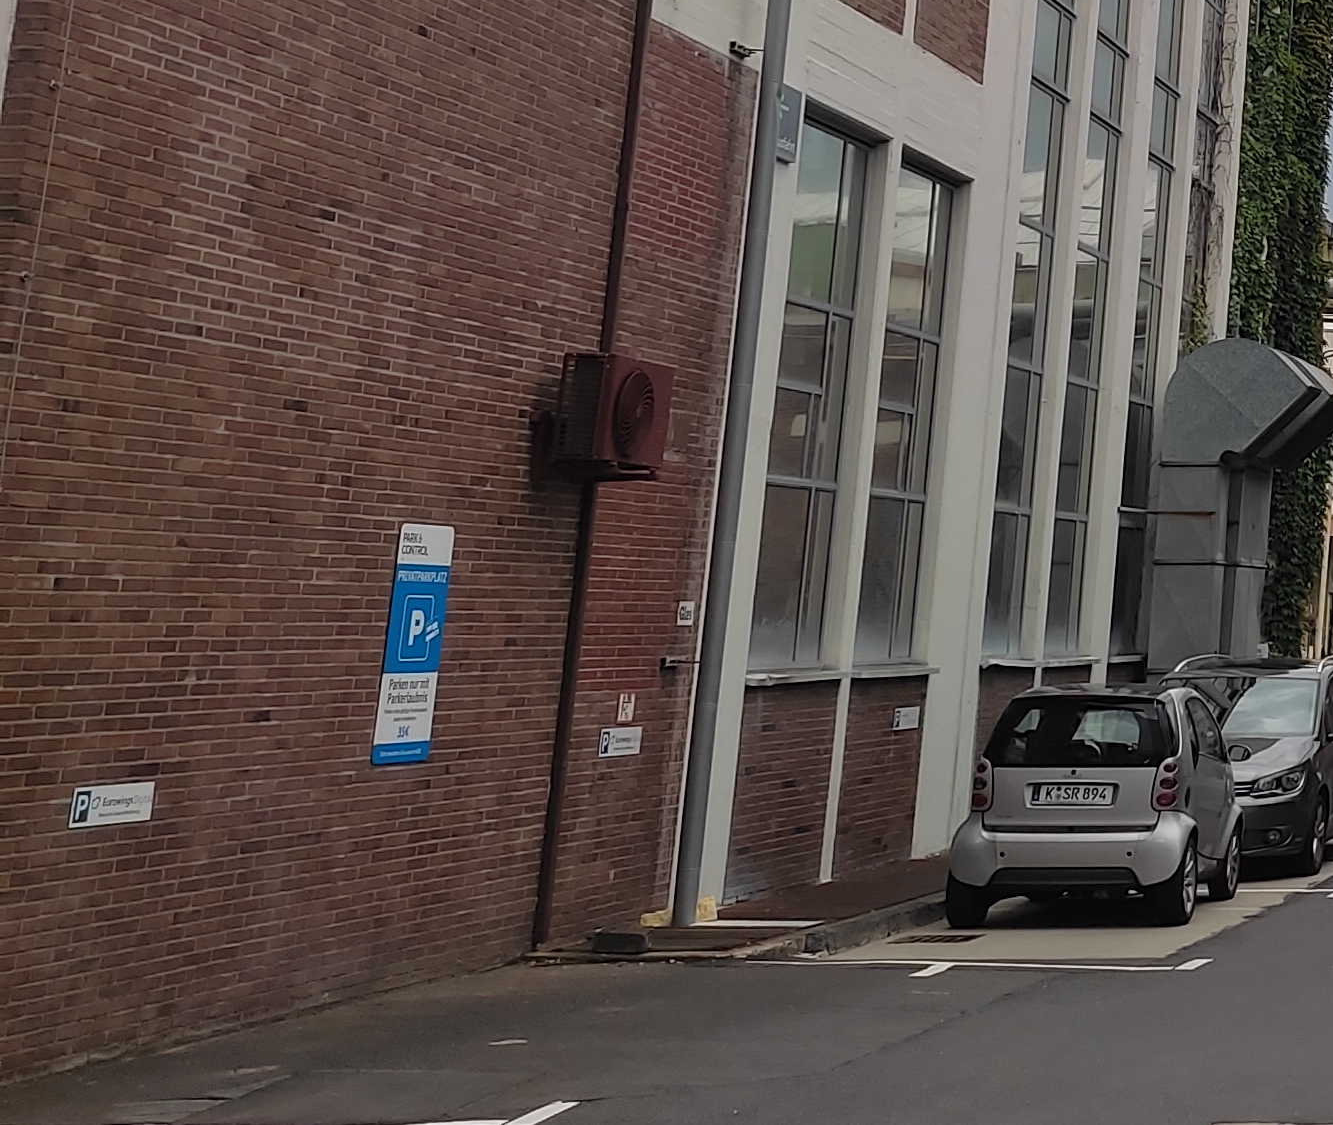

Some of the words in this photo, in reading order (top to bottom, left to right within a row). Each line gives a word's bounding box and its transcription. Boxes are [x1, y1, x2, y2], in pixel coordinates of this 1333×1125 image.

[402, 545, 428, 556] CONTROL
[398, 570, 447, 583] PRIVATPARKPLATZ
[408, 610, 425, 646] P
[389, 678, 408, 690] Parken
[387, 692, 428, 704] Parkerlaubnis
[1045, 787, 1055, 800] K
[1062, 787, 1080, 800] SR
[1082, 787, 1107, 800] 894
[74, 795, 89, 820] P
